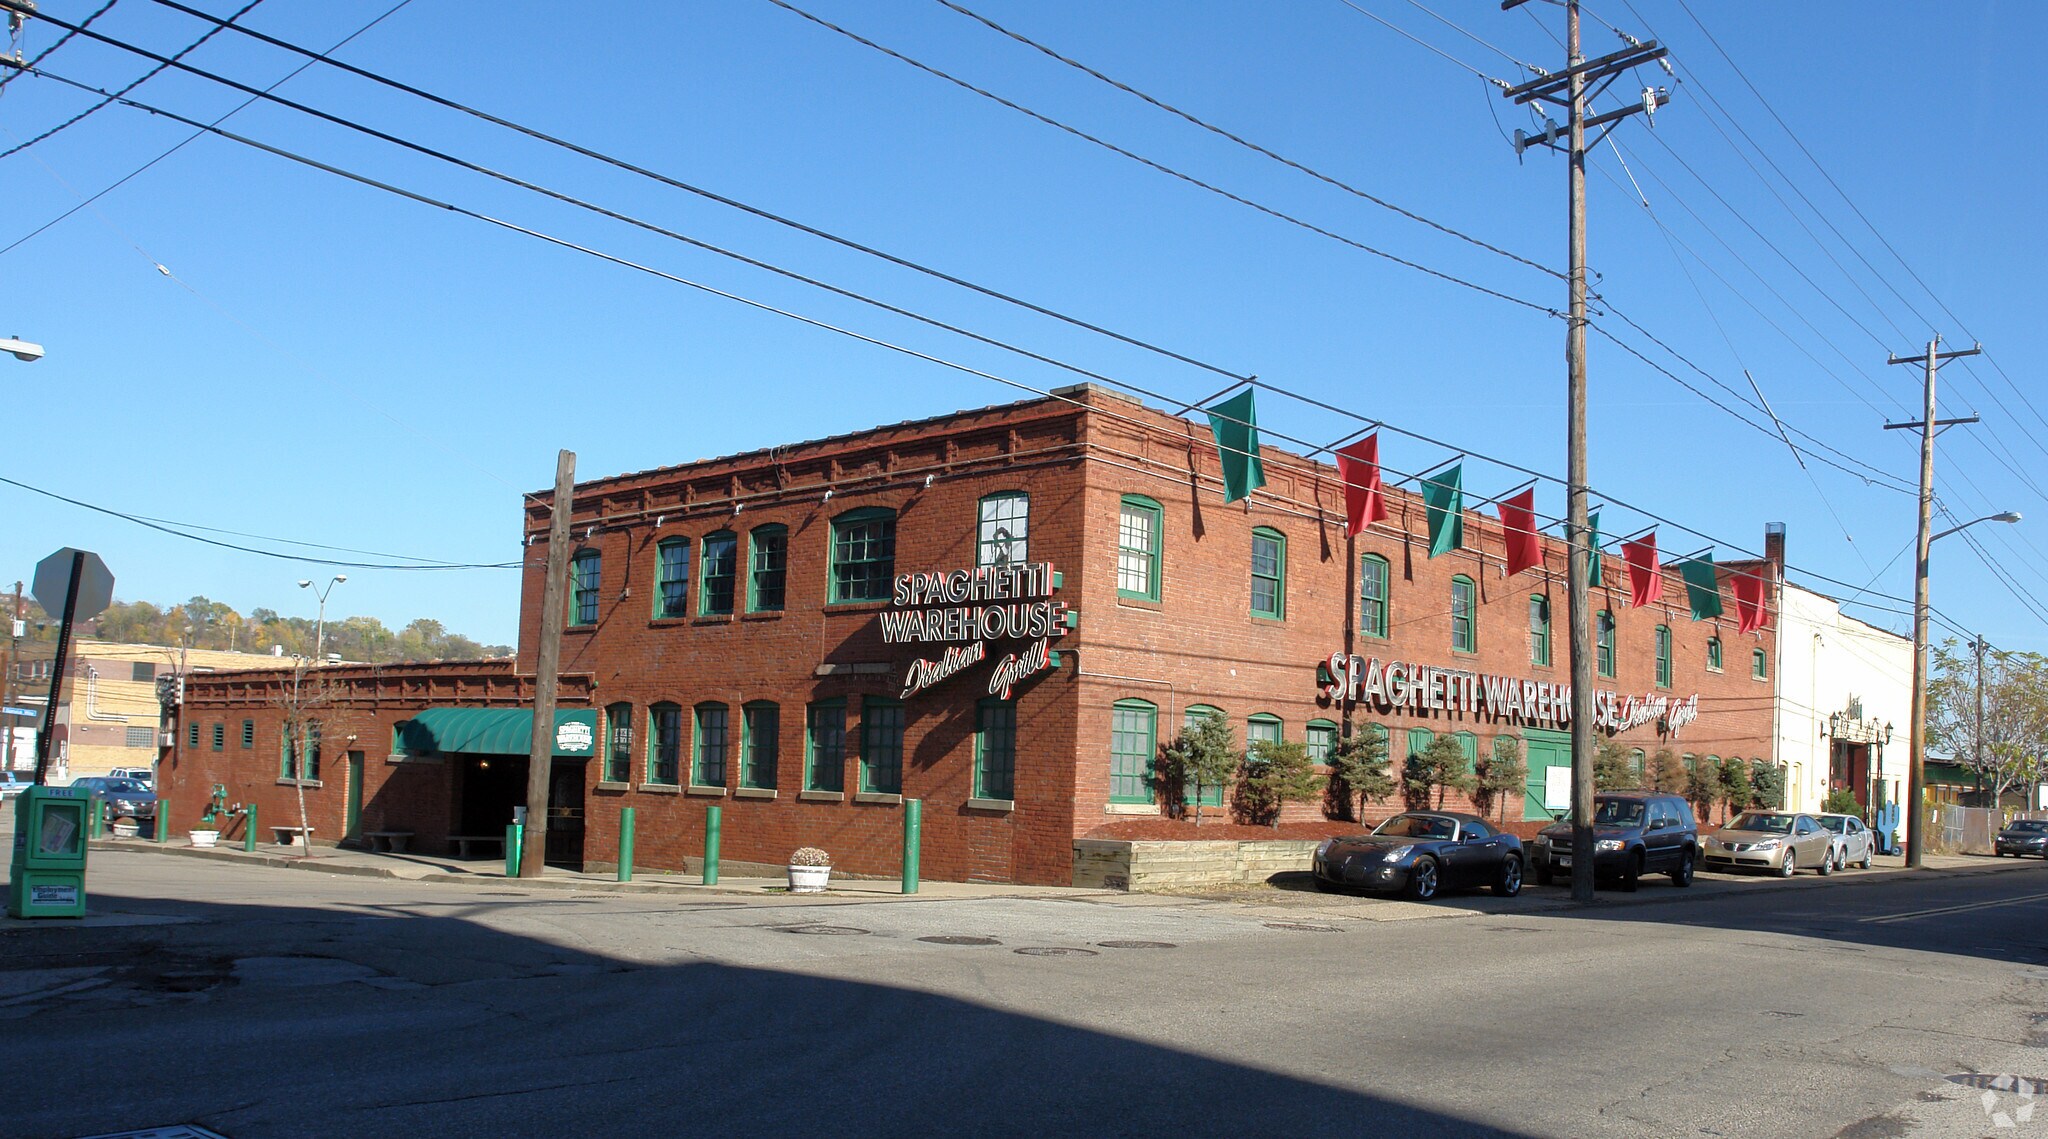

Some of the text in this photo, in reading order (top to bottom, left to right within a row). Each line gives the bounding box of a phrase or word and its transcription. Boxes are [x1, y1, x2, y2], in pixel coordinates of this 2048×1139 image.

[893, 562, 1053, 606] SPAGHETTI
[880, 602, 1067, 643] WAREHOUSE
[900, 637, 1049, 700] Italian Grill
[1325, 650, 1478, 713] SPAGHETTI
[1619, 692, 1668, 731] Italian
[1669, 693, 1699, 739] Grill
